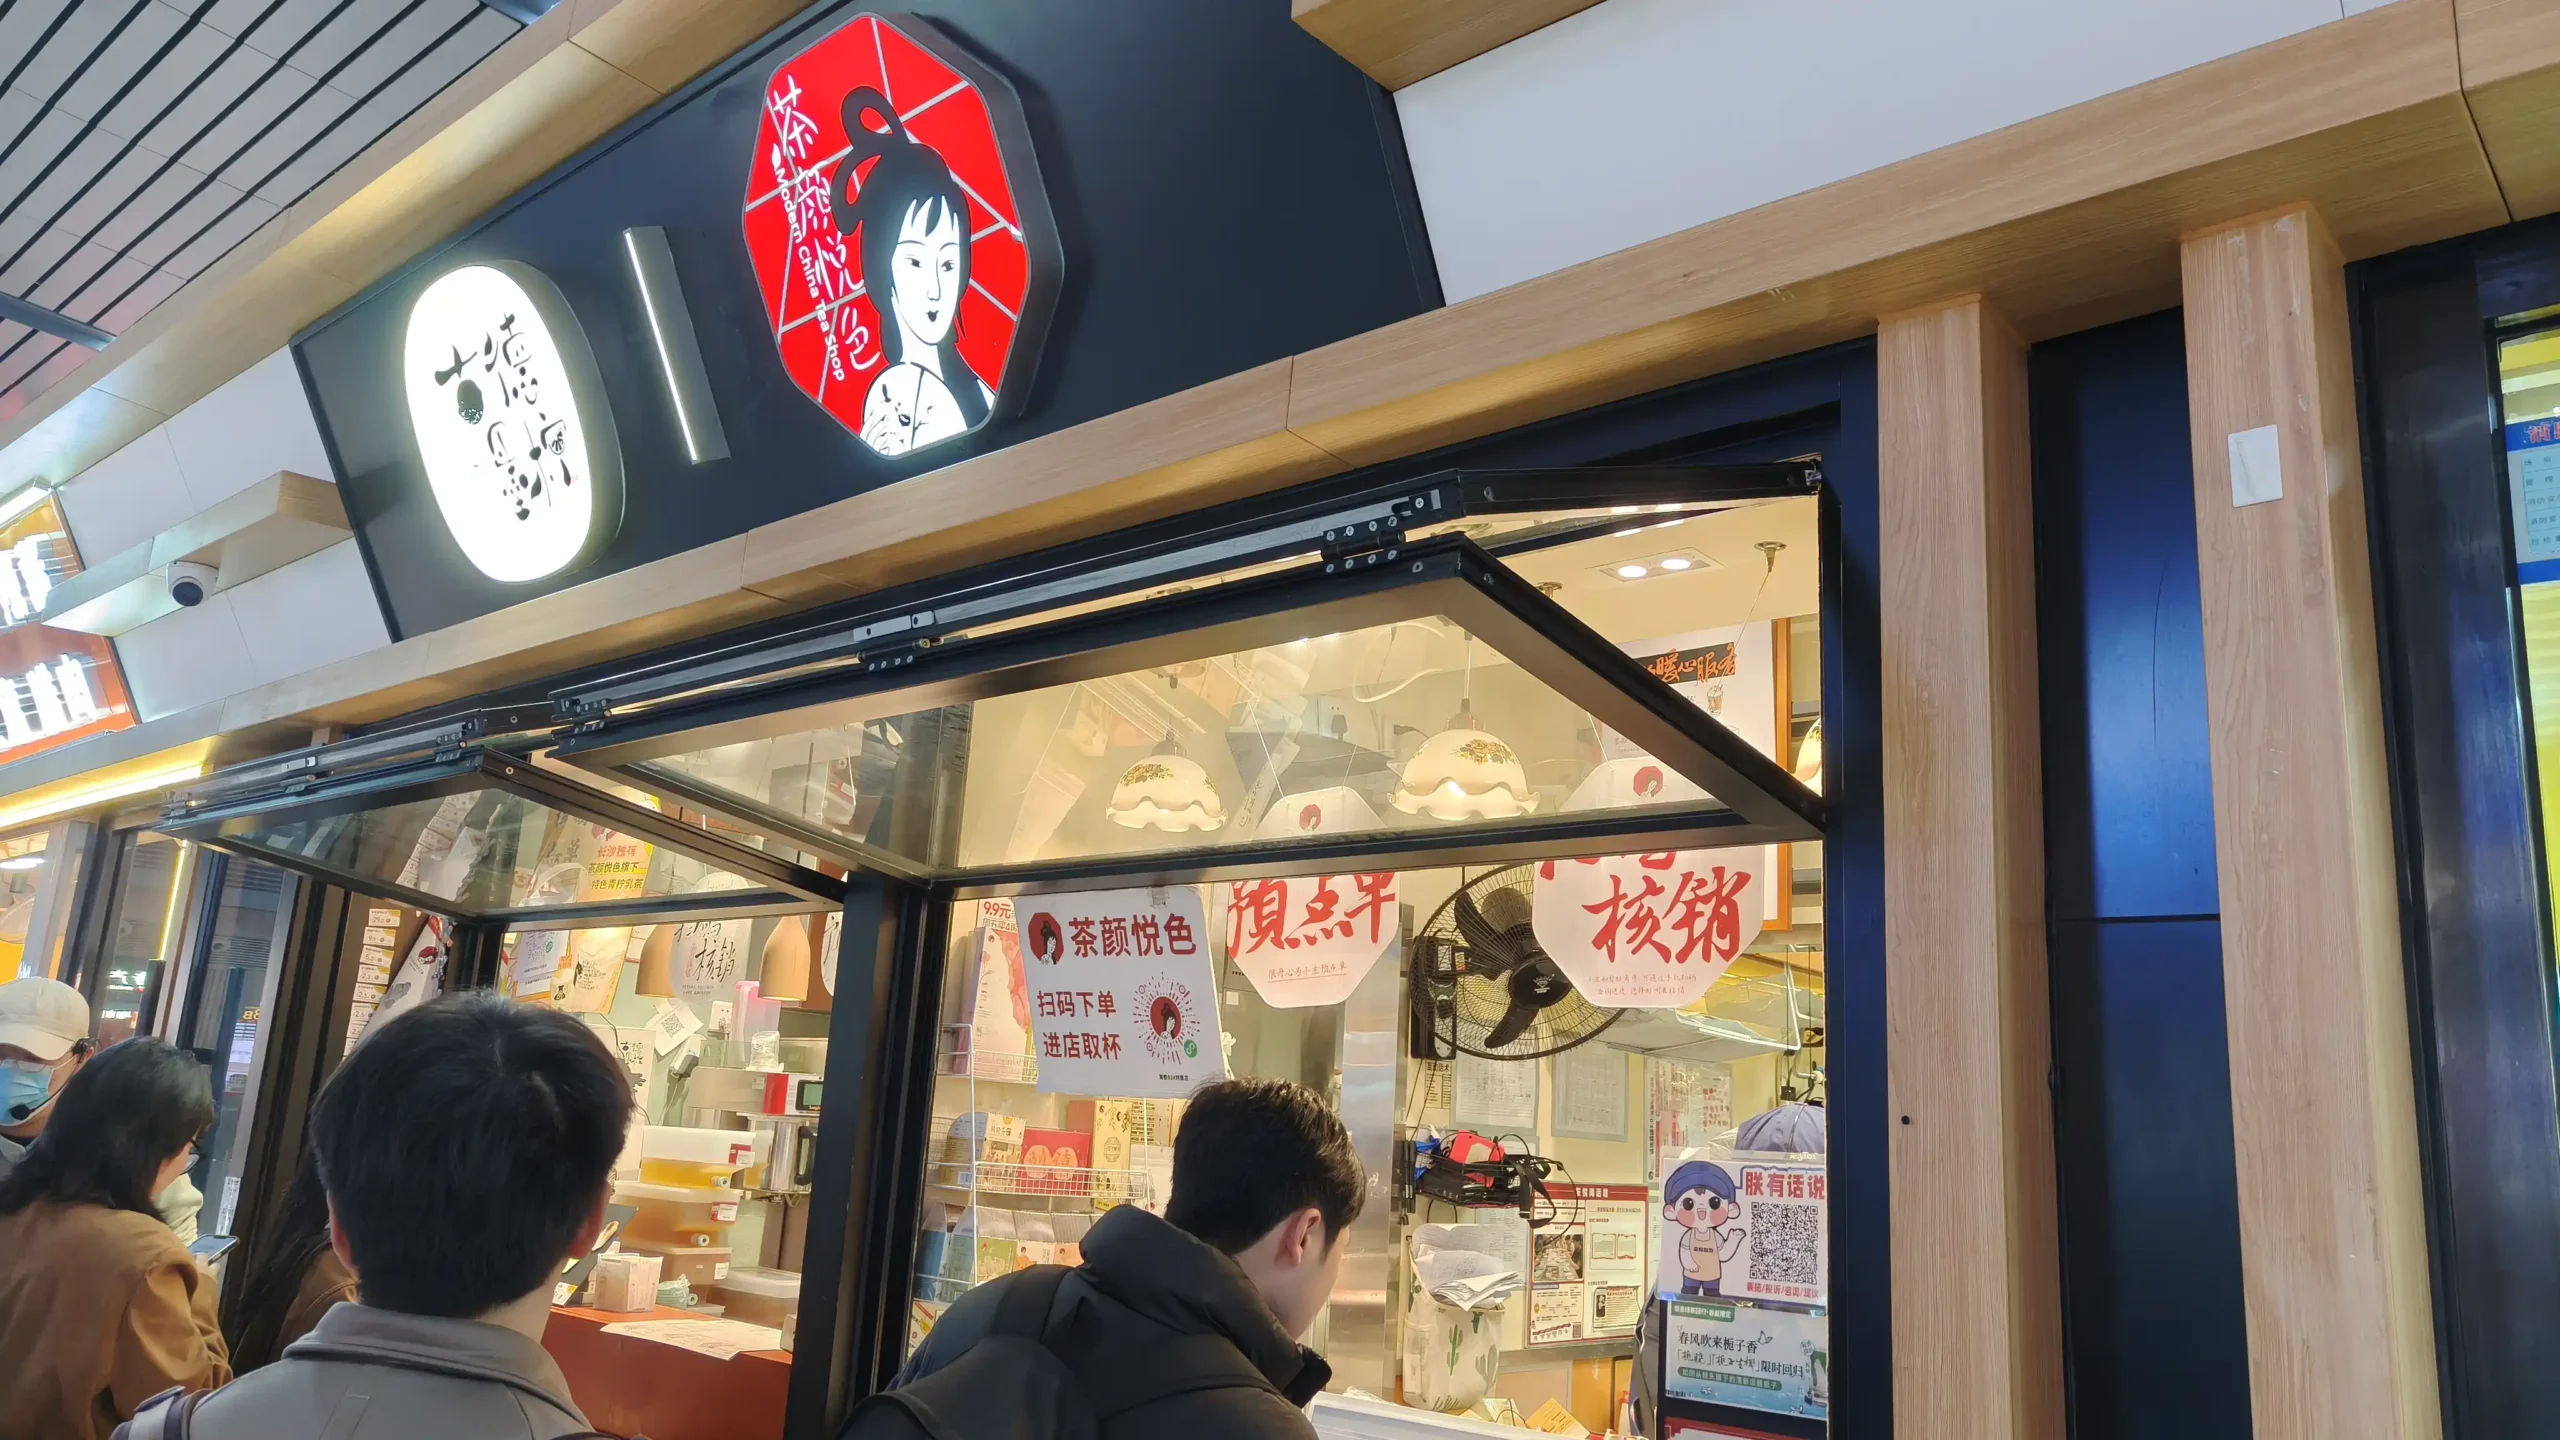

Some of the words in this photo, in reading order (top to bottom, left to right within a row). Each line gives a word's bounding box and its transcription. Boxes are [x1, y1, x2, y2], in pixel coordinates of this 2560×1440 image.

[774, 167, 805, 245] Modern
[797, 245, 820, 299] China
[814, 299, 833, 333] Tea
[825, 333, 847, 382] Shop
[1068, 912, 1197, 959] 茶颜悦色
[1036, 990, 1117, 1018] 扫码下单
[1043, 1031, 1121, 1061] 进店取杯
[1745, 1171, 1825, 1200] 朕有话说
[1679, 1331, 1758, 1354] 春风吹来栀子香
